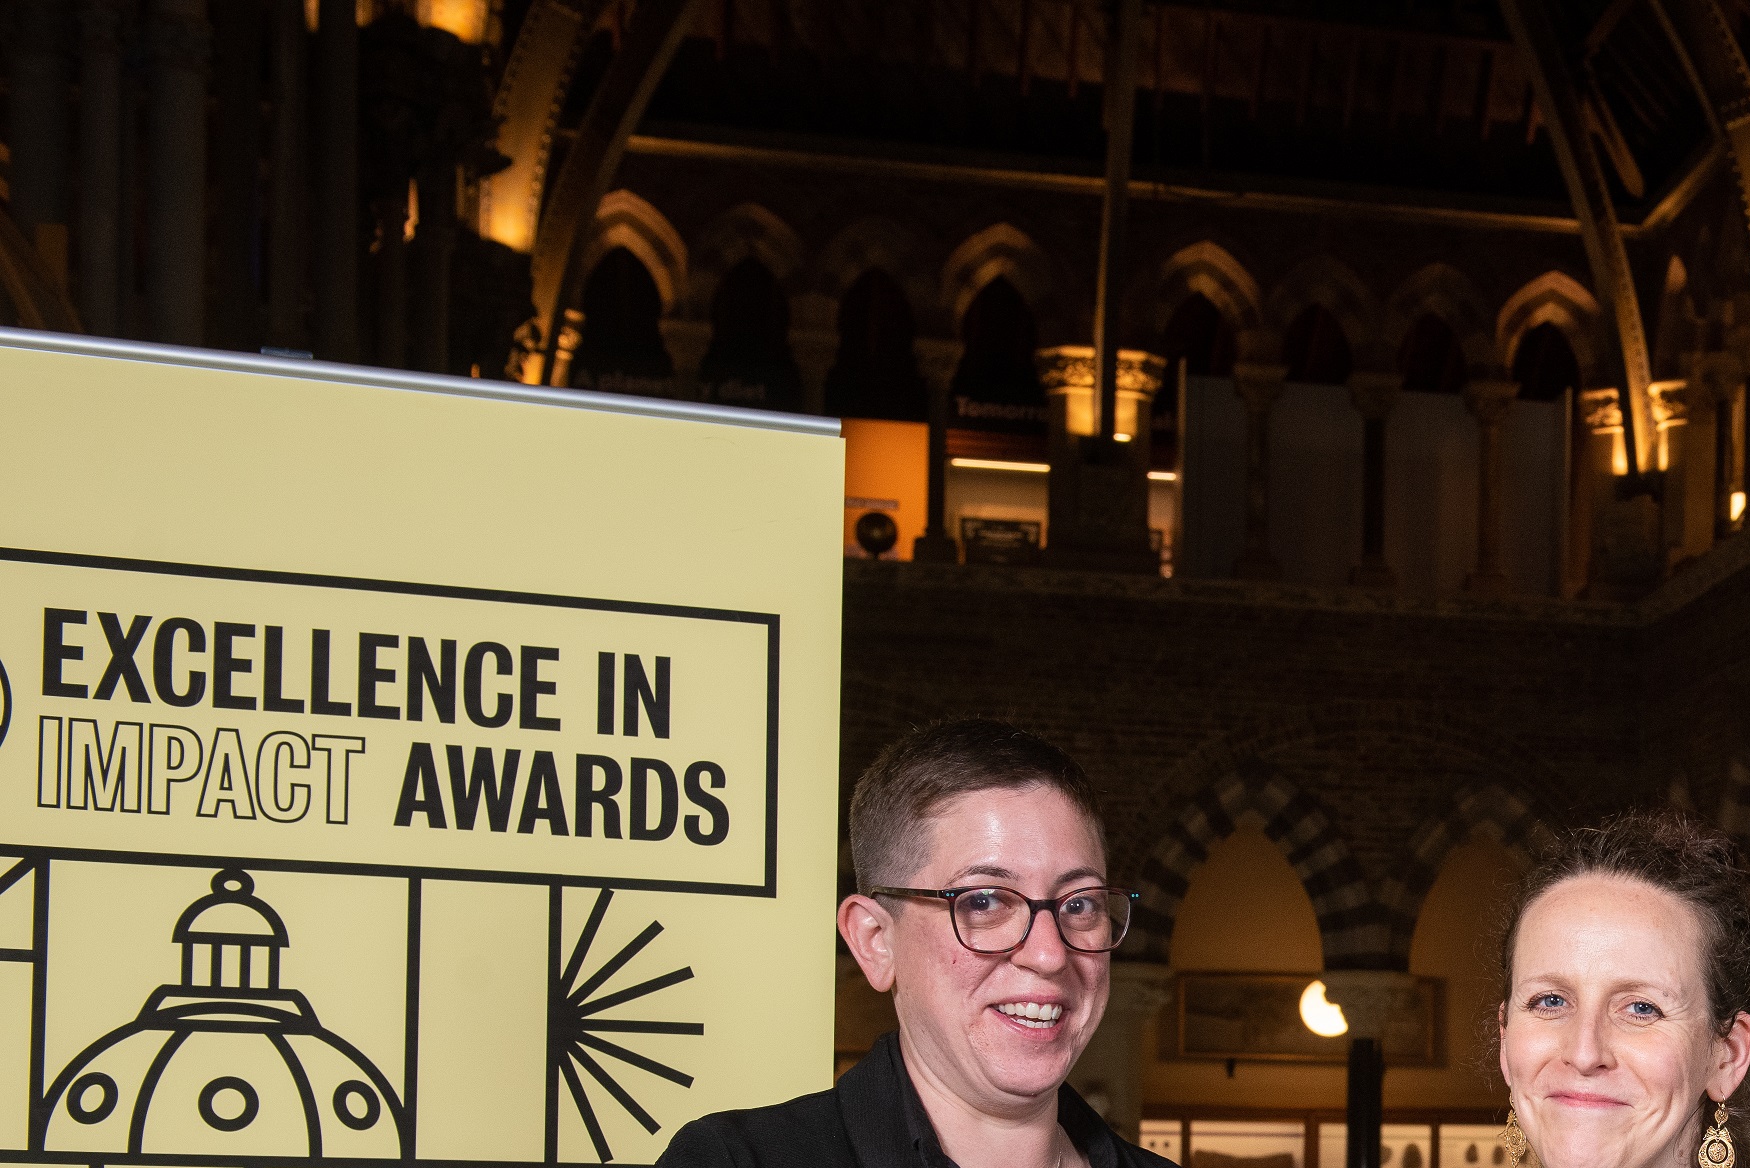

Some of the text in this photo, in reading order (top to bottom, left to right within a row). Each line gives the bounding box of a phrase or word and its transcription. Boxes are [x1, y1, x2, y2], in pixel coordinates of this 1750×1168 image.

[41, 607, 671, 739] EXCELLENCE IN
[37, 715, 730, 846] IMPACT AWARDS
